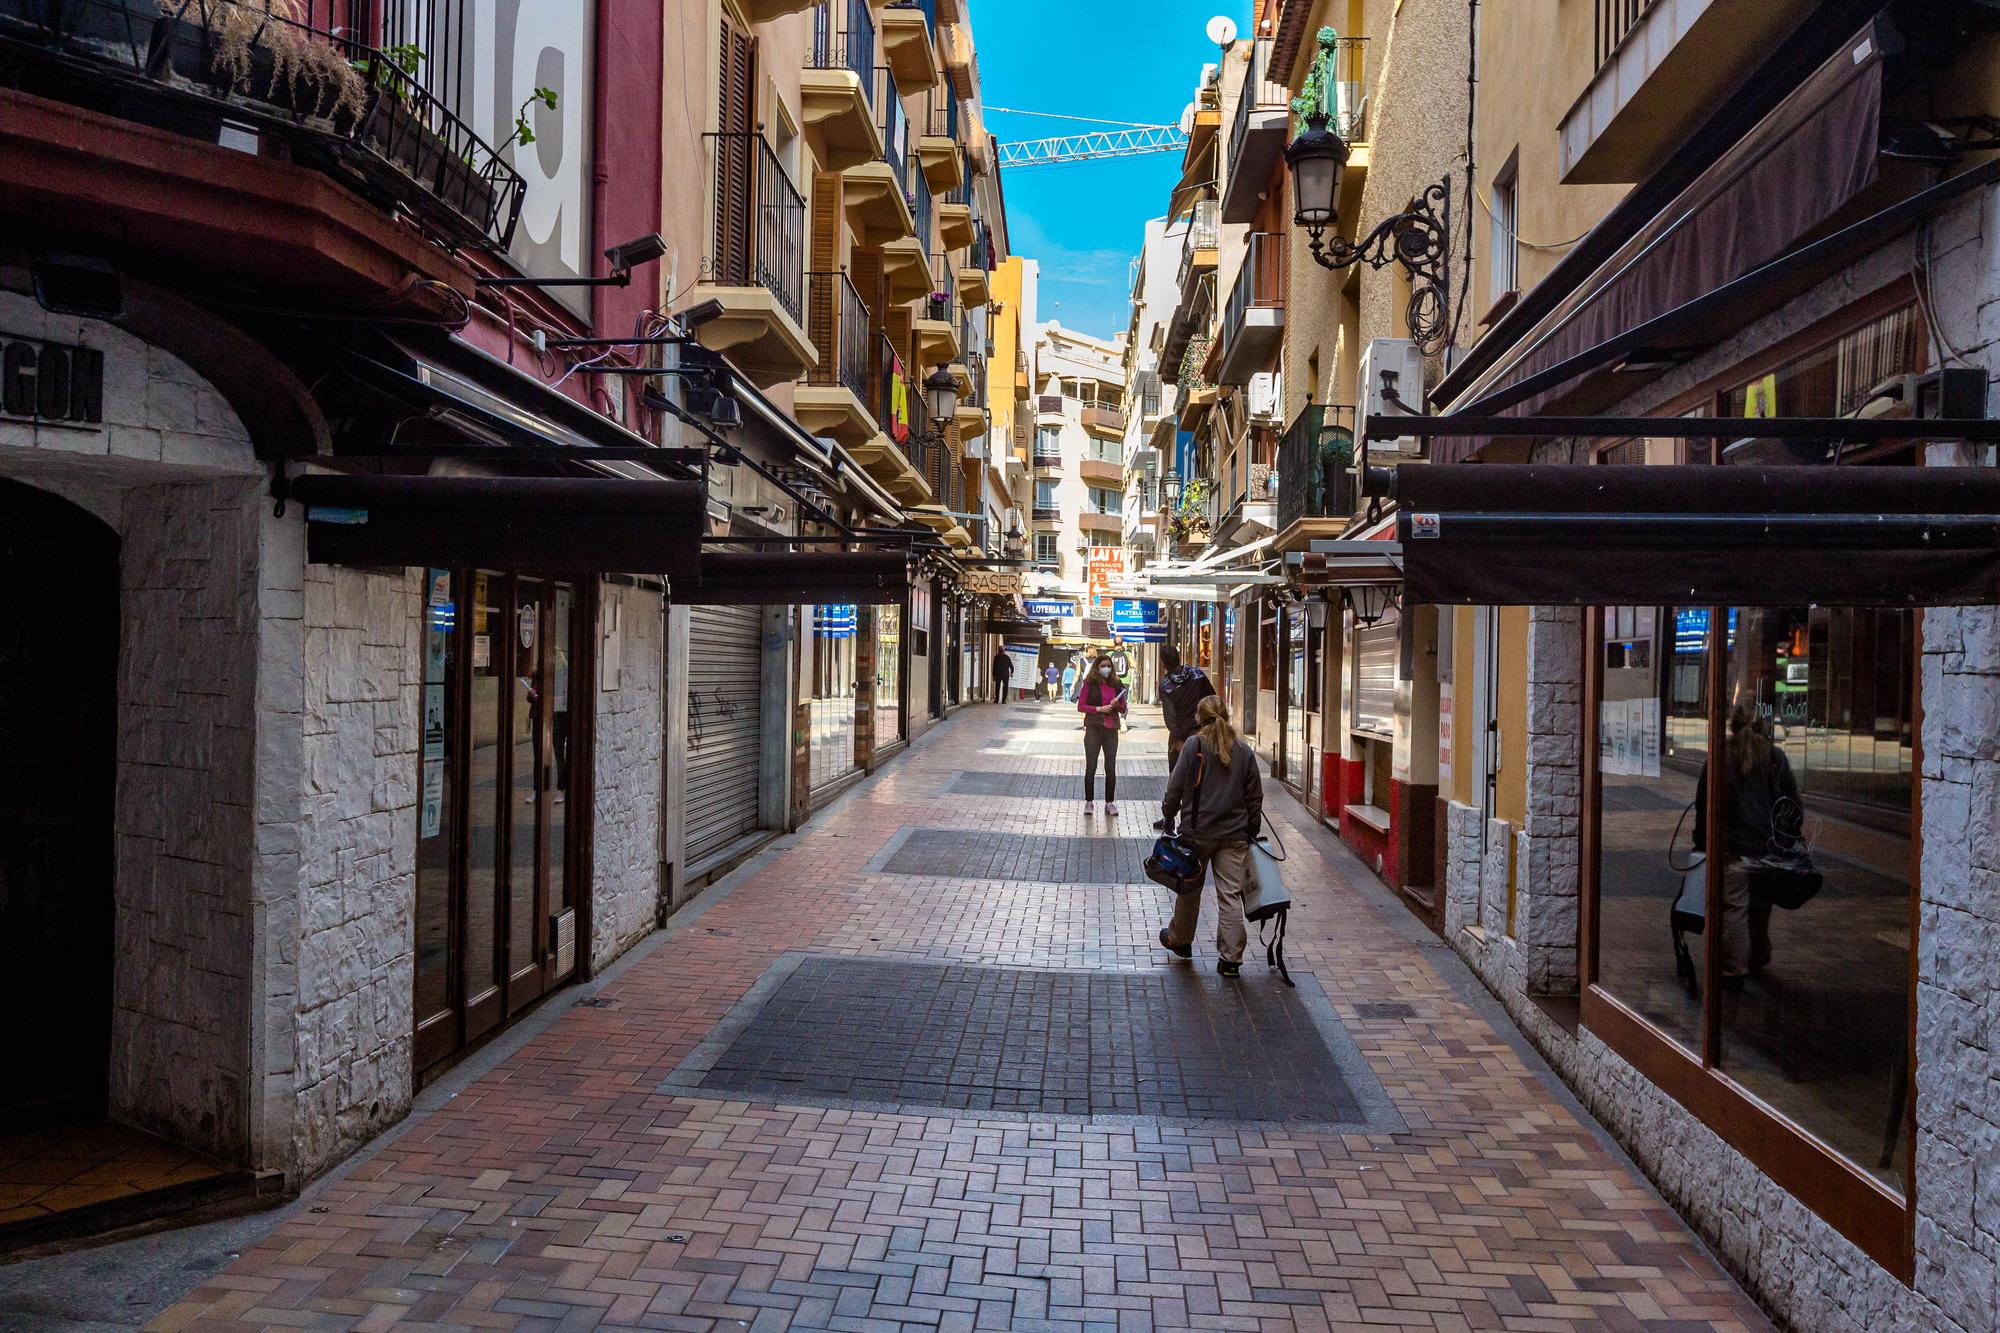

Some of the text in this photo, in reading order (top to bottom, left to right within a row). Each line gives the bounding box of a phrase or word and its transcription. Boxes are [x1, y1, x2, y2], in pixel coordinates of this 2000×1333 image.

[0, 341, 103, 423] GON
[1032, 605, 1060, 614] LOTERIA
[1753, 676, 1774, 739] Hay
